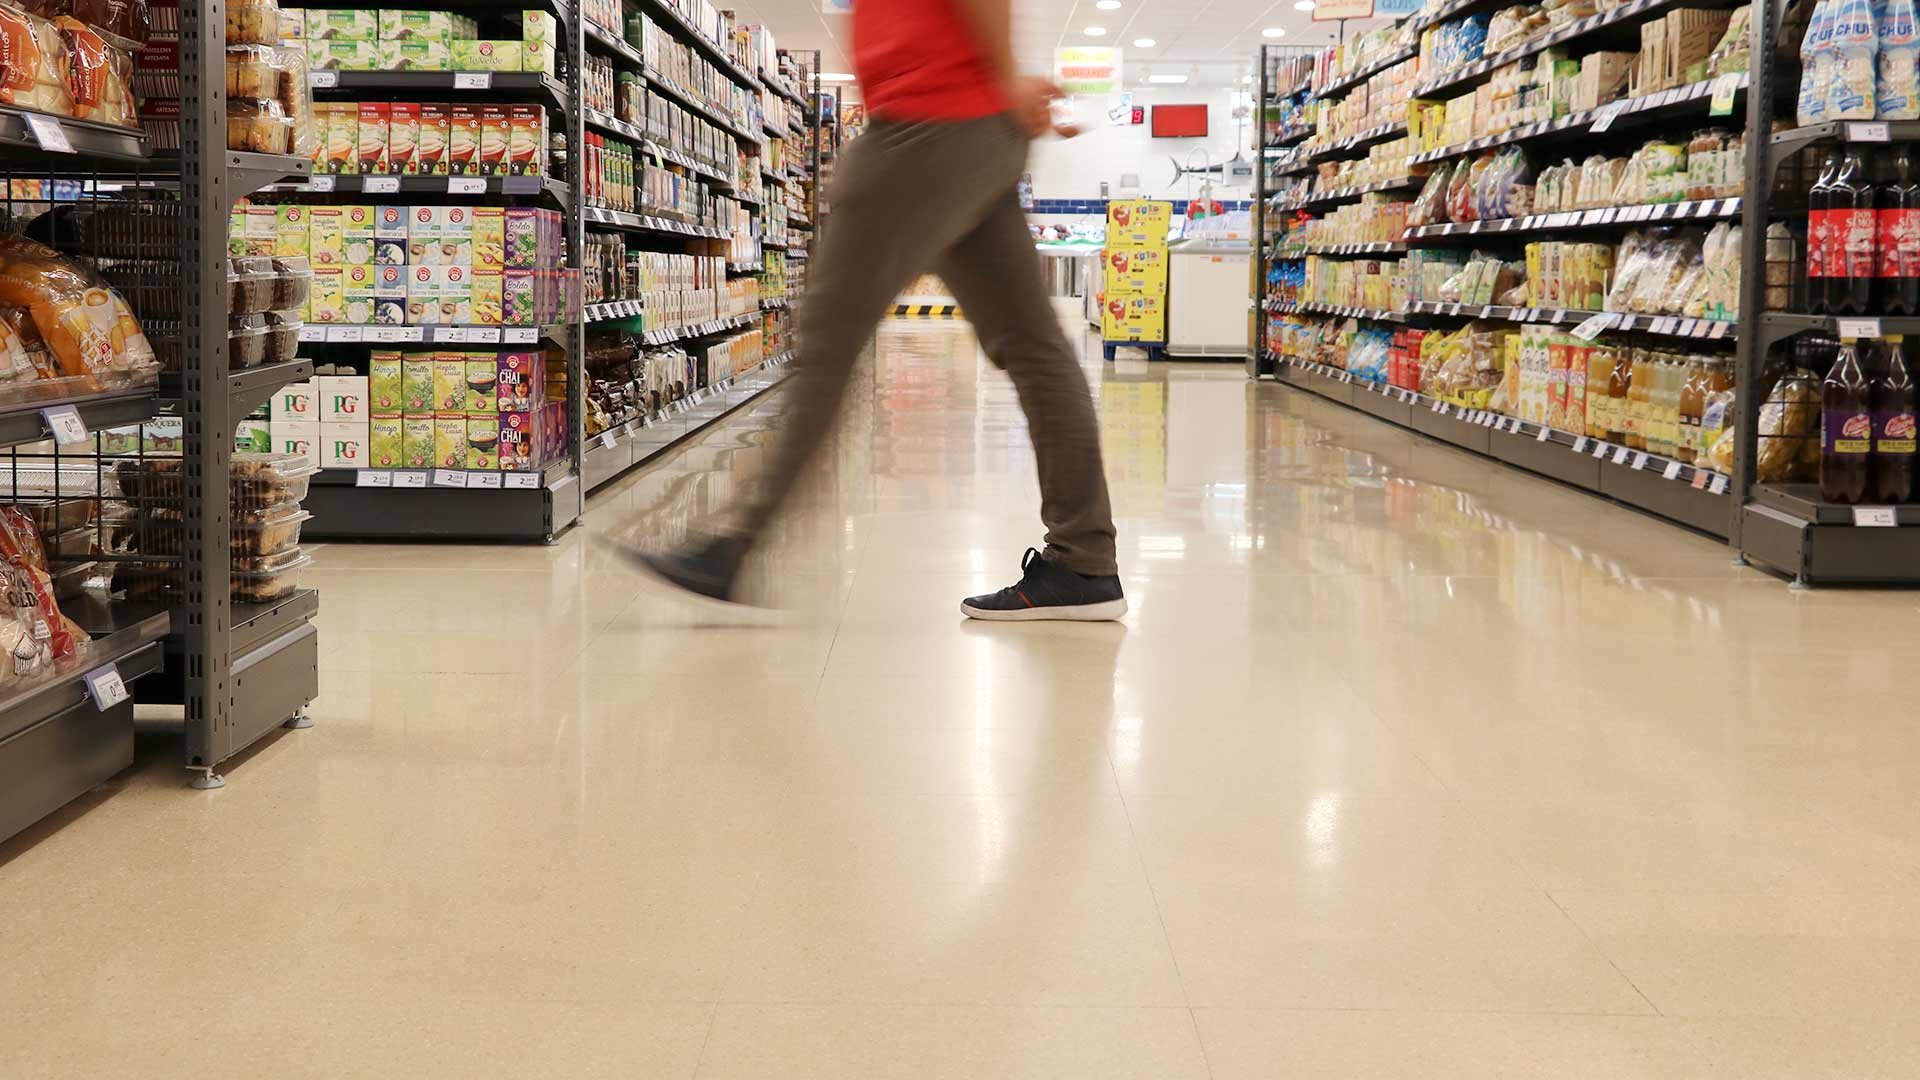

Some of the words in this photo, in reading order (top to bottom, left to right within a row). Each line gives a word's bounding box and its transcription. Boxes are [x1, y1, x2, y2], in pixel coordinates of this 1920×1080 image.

[508, 281, 528, 289] Boldo
[374, 365, 396, 377] Hinojo
[499, 371, 520, 384] CHAI
[284, 395, 306, 412] PG
[334, 395, 355, 413] PG
[65, 420, 72, 432] 0
[374, 424, 397, 436] Hinojo
[501, 430, 521, 443] CHAI
[286, 440, 306, 455] PG
[335, 441, 355, 458] PG
[110, 686, 116, 697] 0
